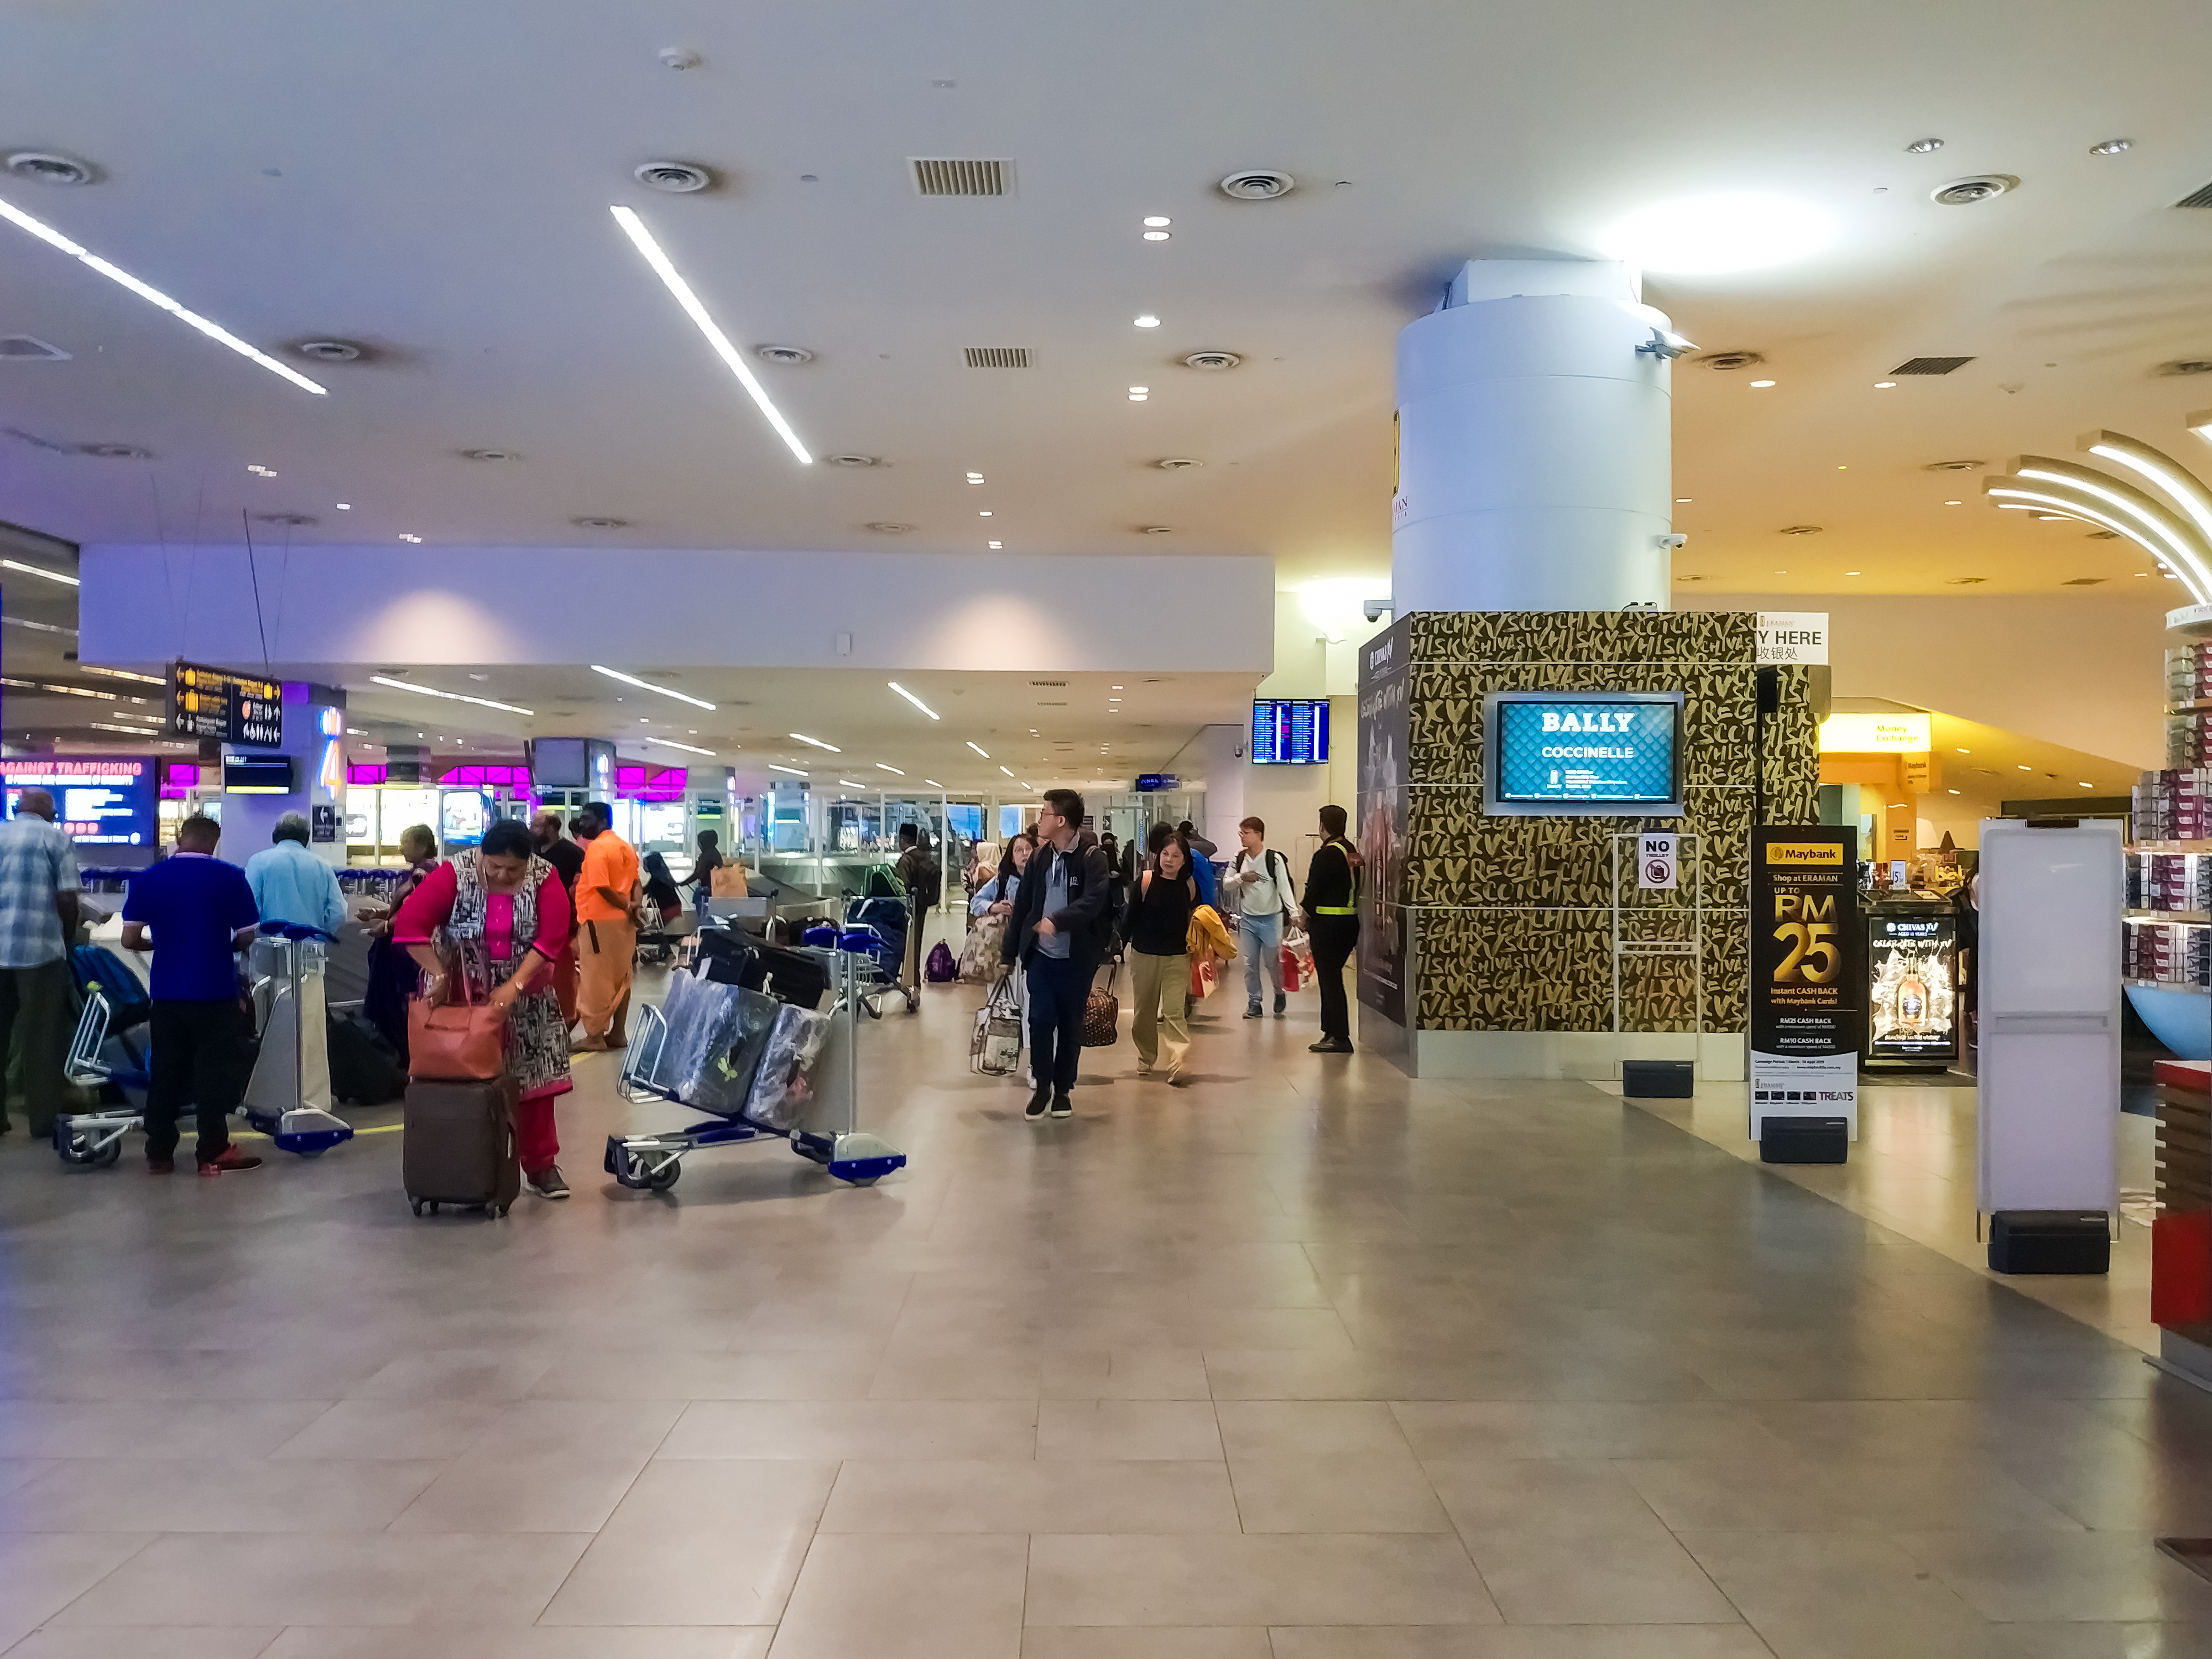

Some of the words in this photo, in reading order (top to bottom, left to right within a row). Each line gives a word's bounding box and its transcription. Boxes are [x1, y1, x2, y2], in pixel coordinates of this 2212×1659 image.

[1775, 630, 1822, 645] HERE
[1757, 646, 1798, 660] 收银处
[1541, 712, 1635, 732] BALLY
[1541, 746, 1634, 759] COCCINELLE
[56, 761, 142, 776] TRAFFICKING
[1646, 841, 1670, 852] NO
[1785, 849, 1836, 861] Maybank
[1773, 874, 1792, 883] Shop
[1775, 894, 1837, 922] RM
[1926, 922, 1939, 932] XV
[1773, 922, 1841, 983] 25
[1787, 998, 1816, 1006] Maybank
[1818, 1091, 1854, 1101] TREATS
